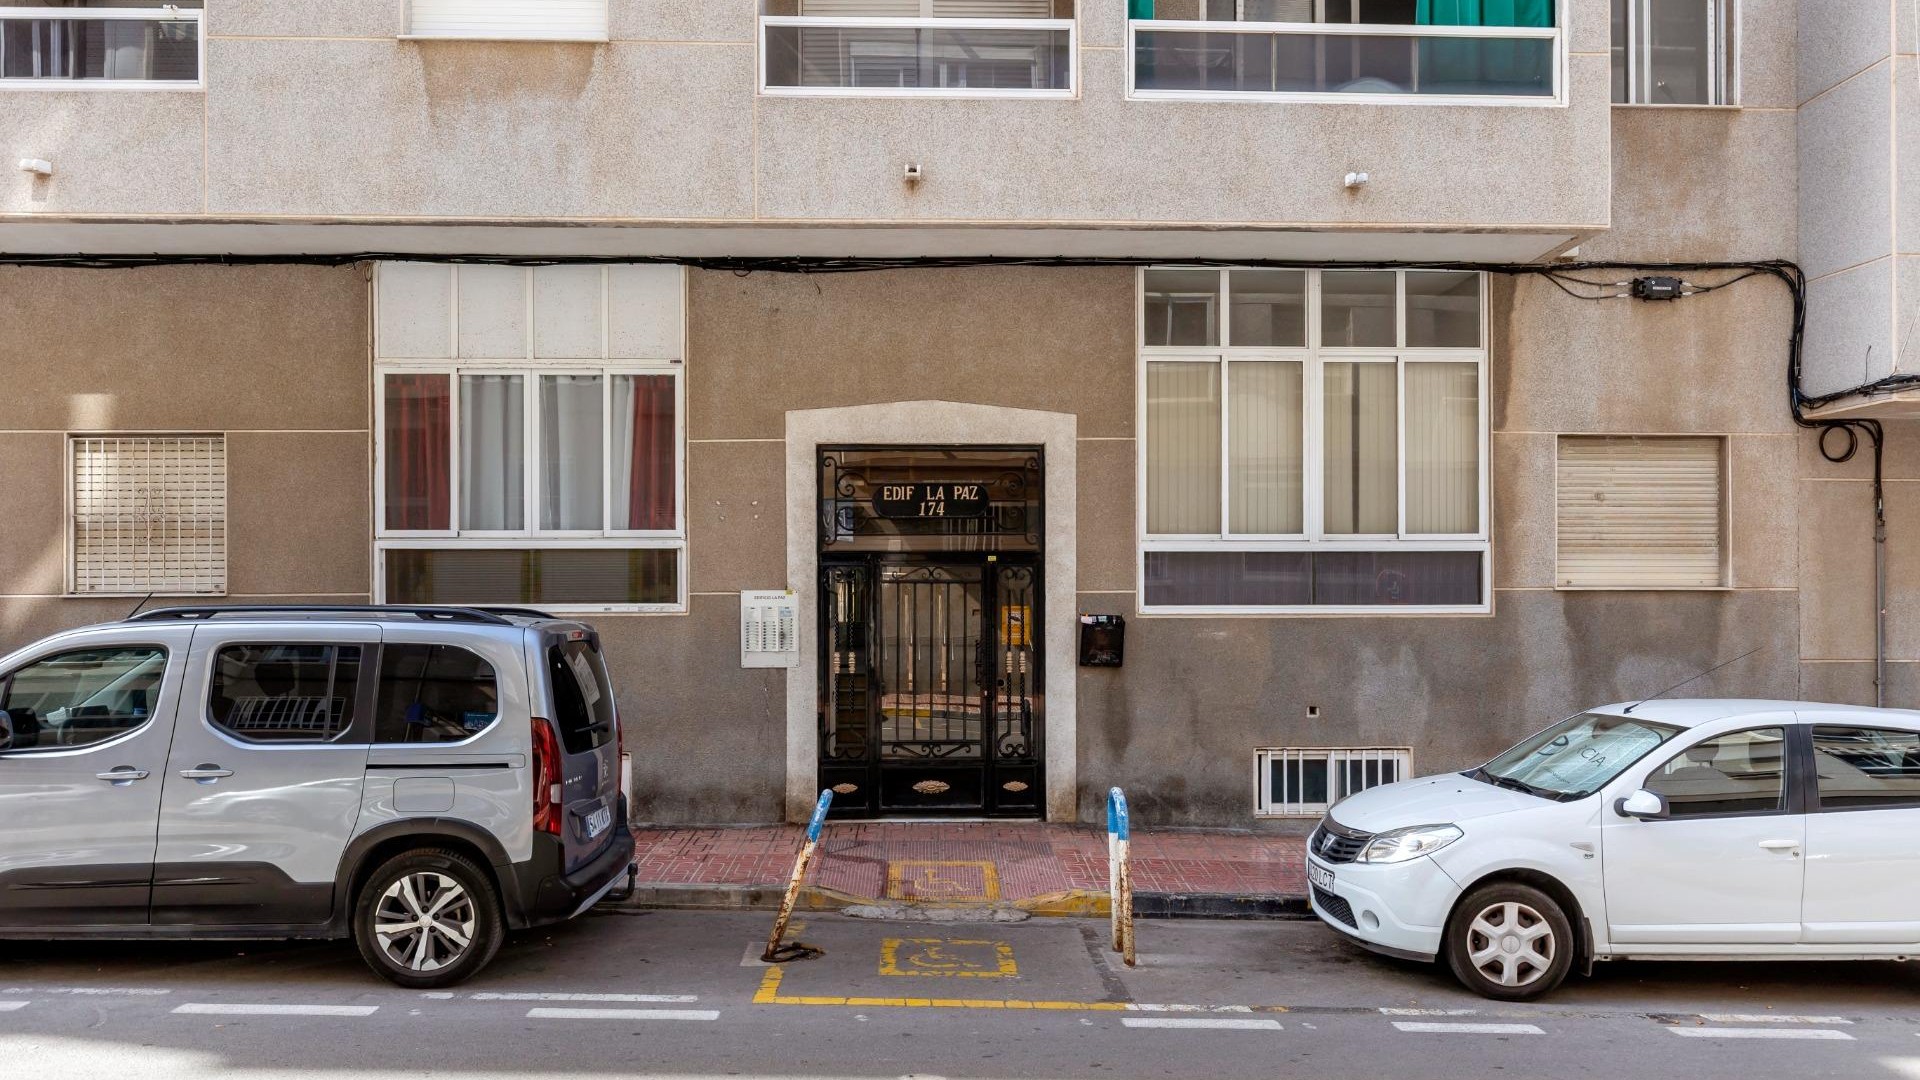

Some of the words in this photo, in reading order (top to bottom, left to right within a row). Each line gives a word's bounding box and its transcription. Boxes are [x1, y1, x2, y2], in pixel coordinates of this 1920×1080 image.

[883, 486, 914, 500] EDIF
[926, 486, 944, 500] LA
[953, 485, 978, 500] PAZ
[919, 501, 945, 516] 174
